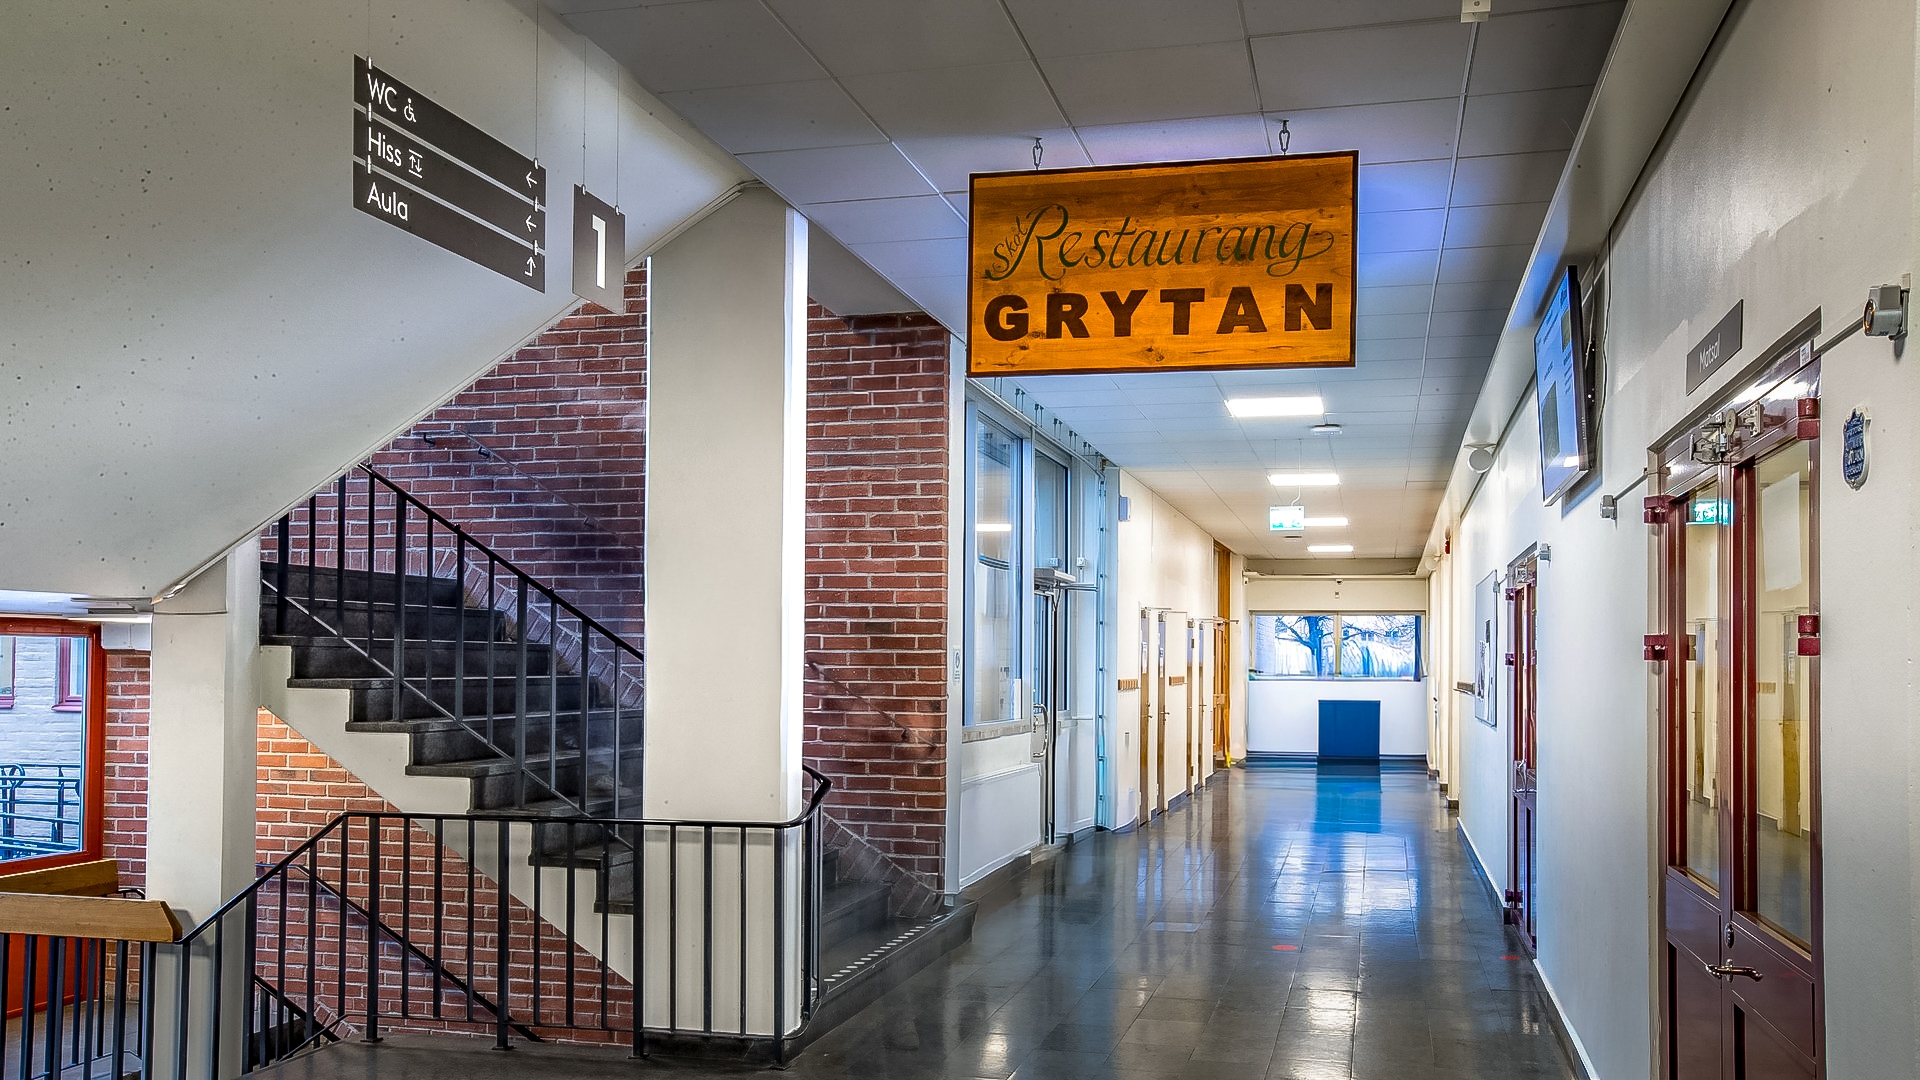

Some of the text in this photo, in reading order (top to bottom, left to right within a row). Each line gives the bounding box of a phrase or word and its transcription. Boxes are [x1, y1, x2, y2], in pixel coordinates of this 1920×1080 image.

[367, 73, 397, 112] WC
[368, 127, 402, 167] Hiss
[367, 182, 408, 221] Aula
[592, 214, 606, 289] 1
[985, 203, 1334, 281] Restaurang
[983, 282, 1333, 341] GRYTAN
[1699, 332, 1720, 373] Matsal
